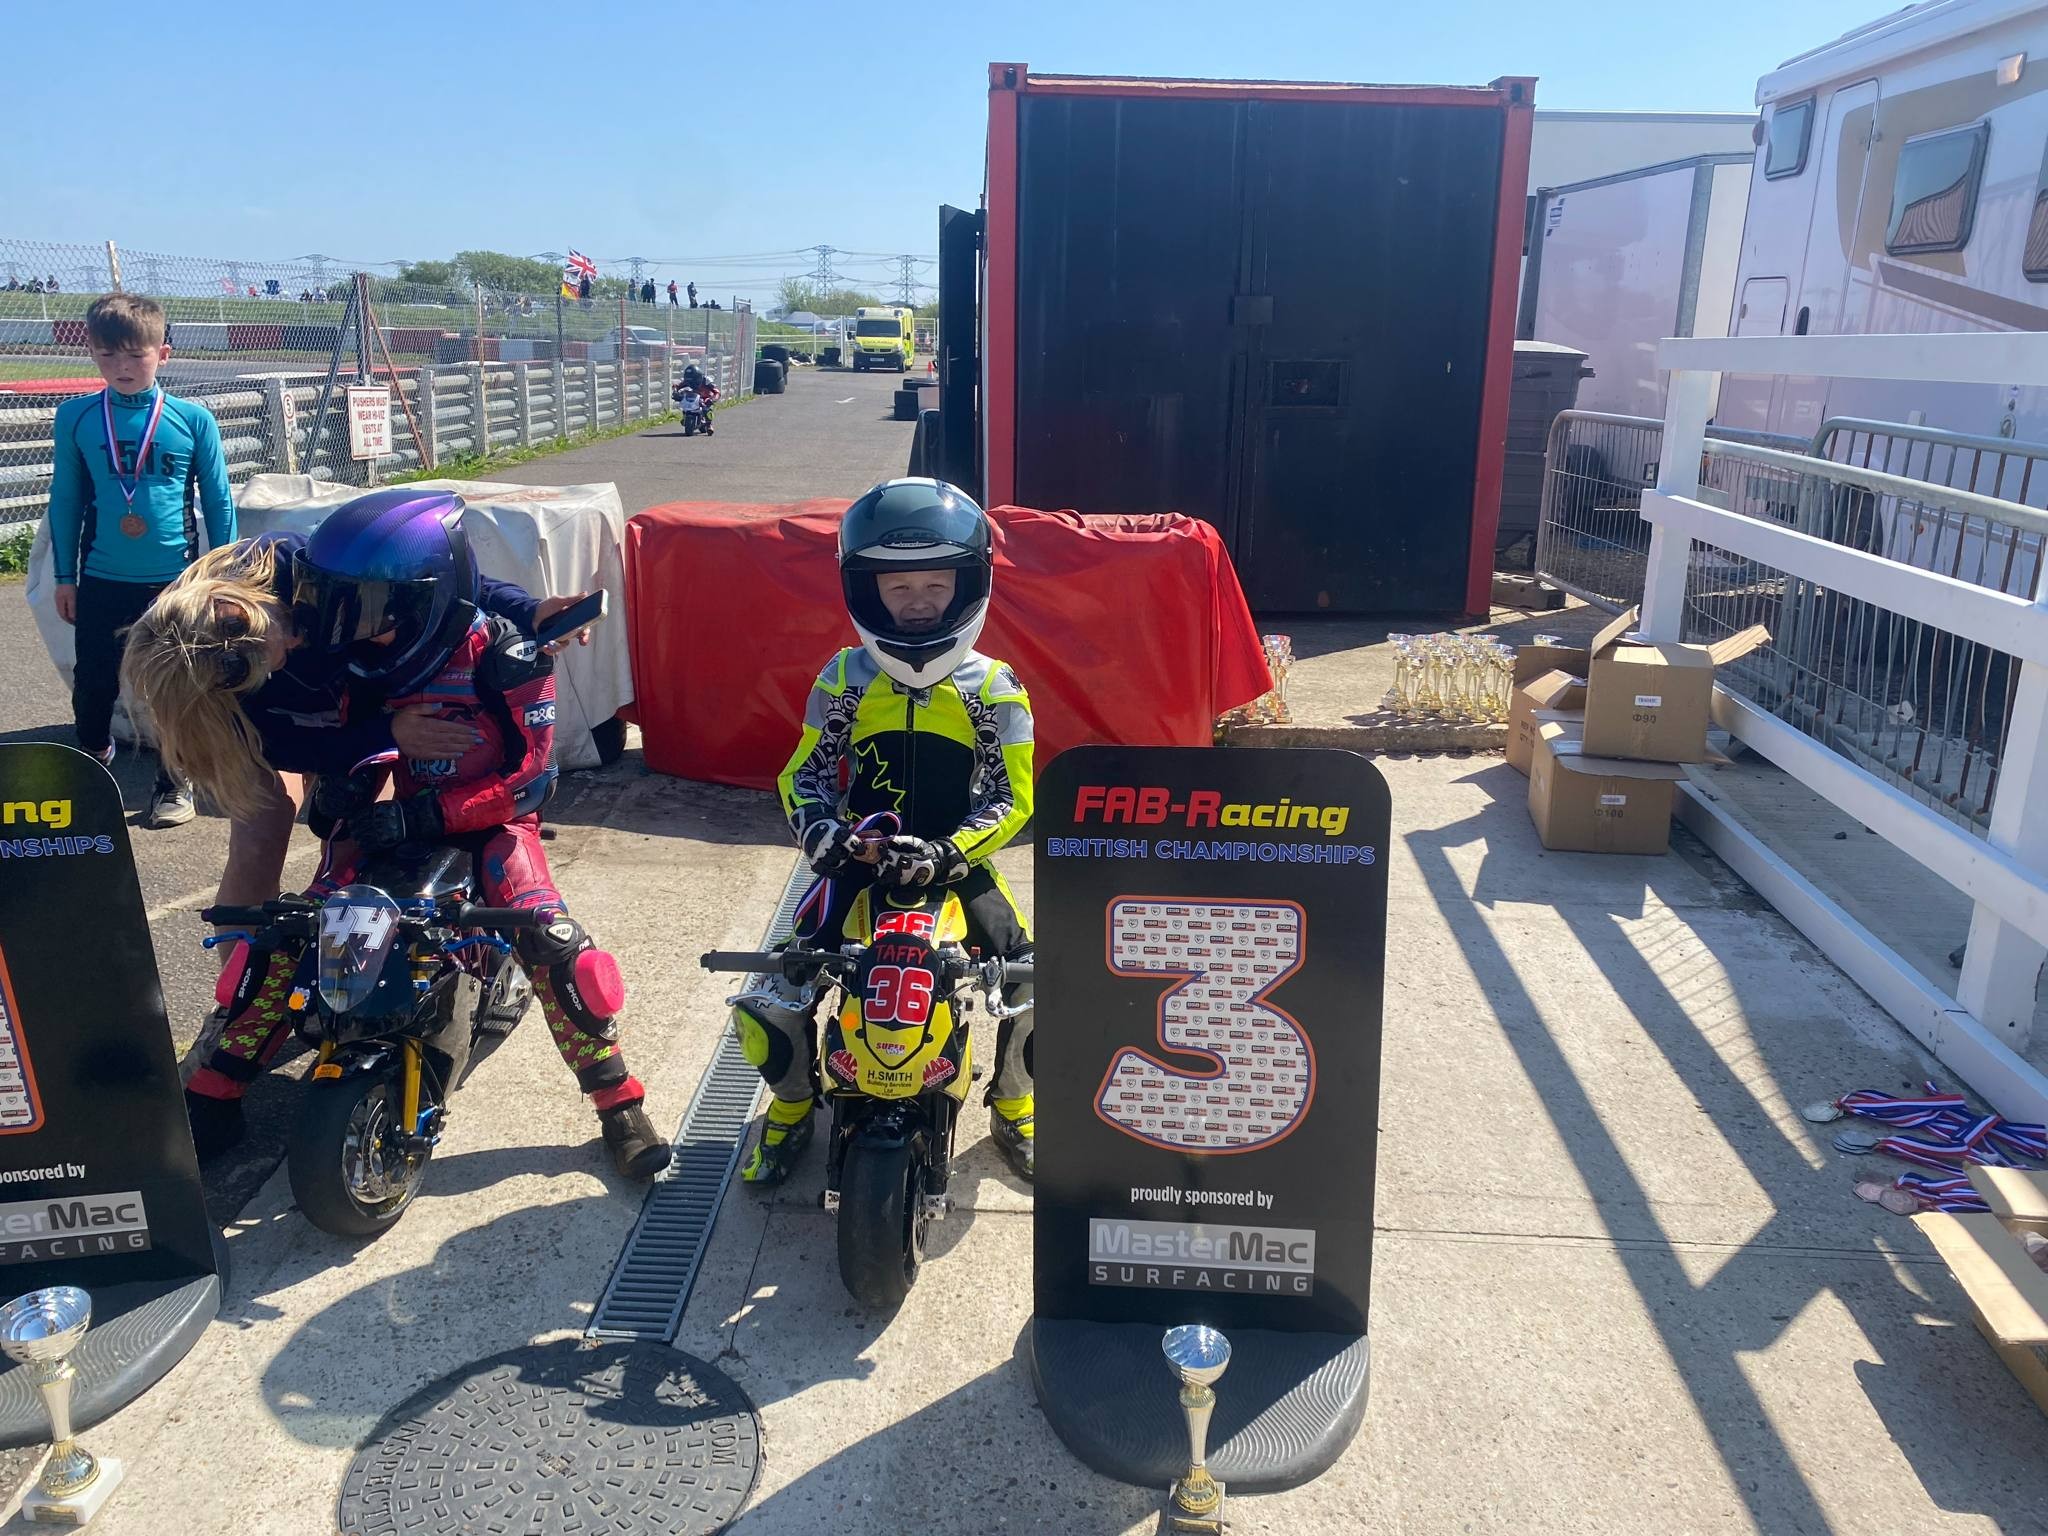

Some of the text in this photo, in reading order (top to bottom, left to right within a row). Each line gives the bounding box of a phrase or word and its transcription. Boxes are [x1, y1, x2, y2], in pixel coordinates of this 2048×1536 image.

[1073, 785, 1350, 836] FAB-Racing
[1047, 837, 1376, 865] BRITISH CHAMPIONSHIPS
[322, 904, 393, 950] 44
[876, 944, 929, 965] TAFFY
[238, 967, 252, 998] SHOP
[565, 982, 583, 1011] SHOP
[864, 965, 935, 1025] 36
[1094, 895, 1316, 1156] 3
[867, 1069, 913, 1081] H.SMITH
[0, 1163, 86, 1184] onsored by
[1130, 1186, 1274, 1209] proudly sponsored by
[1095, 1223, 1309, 1264] MasterMac
[1095, 1266, 1308, 1292] SURFACING
